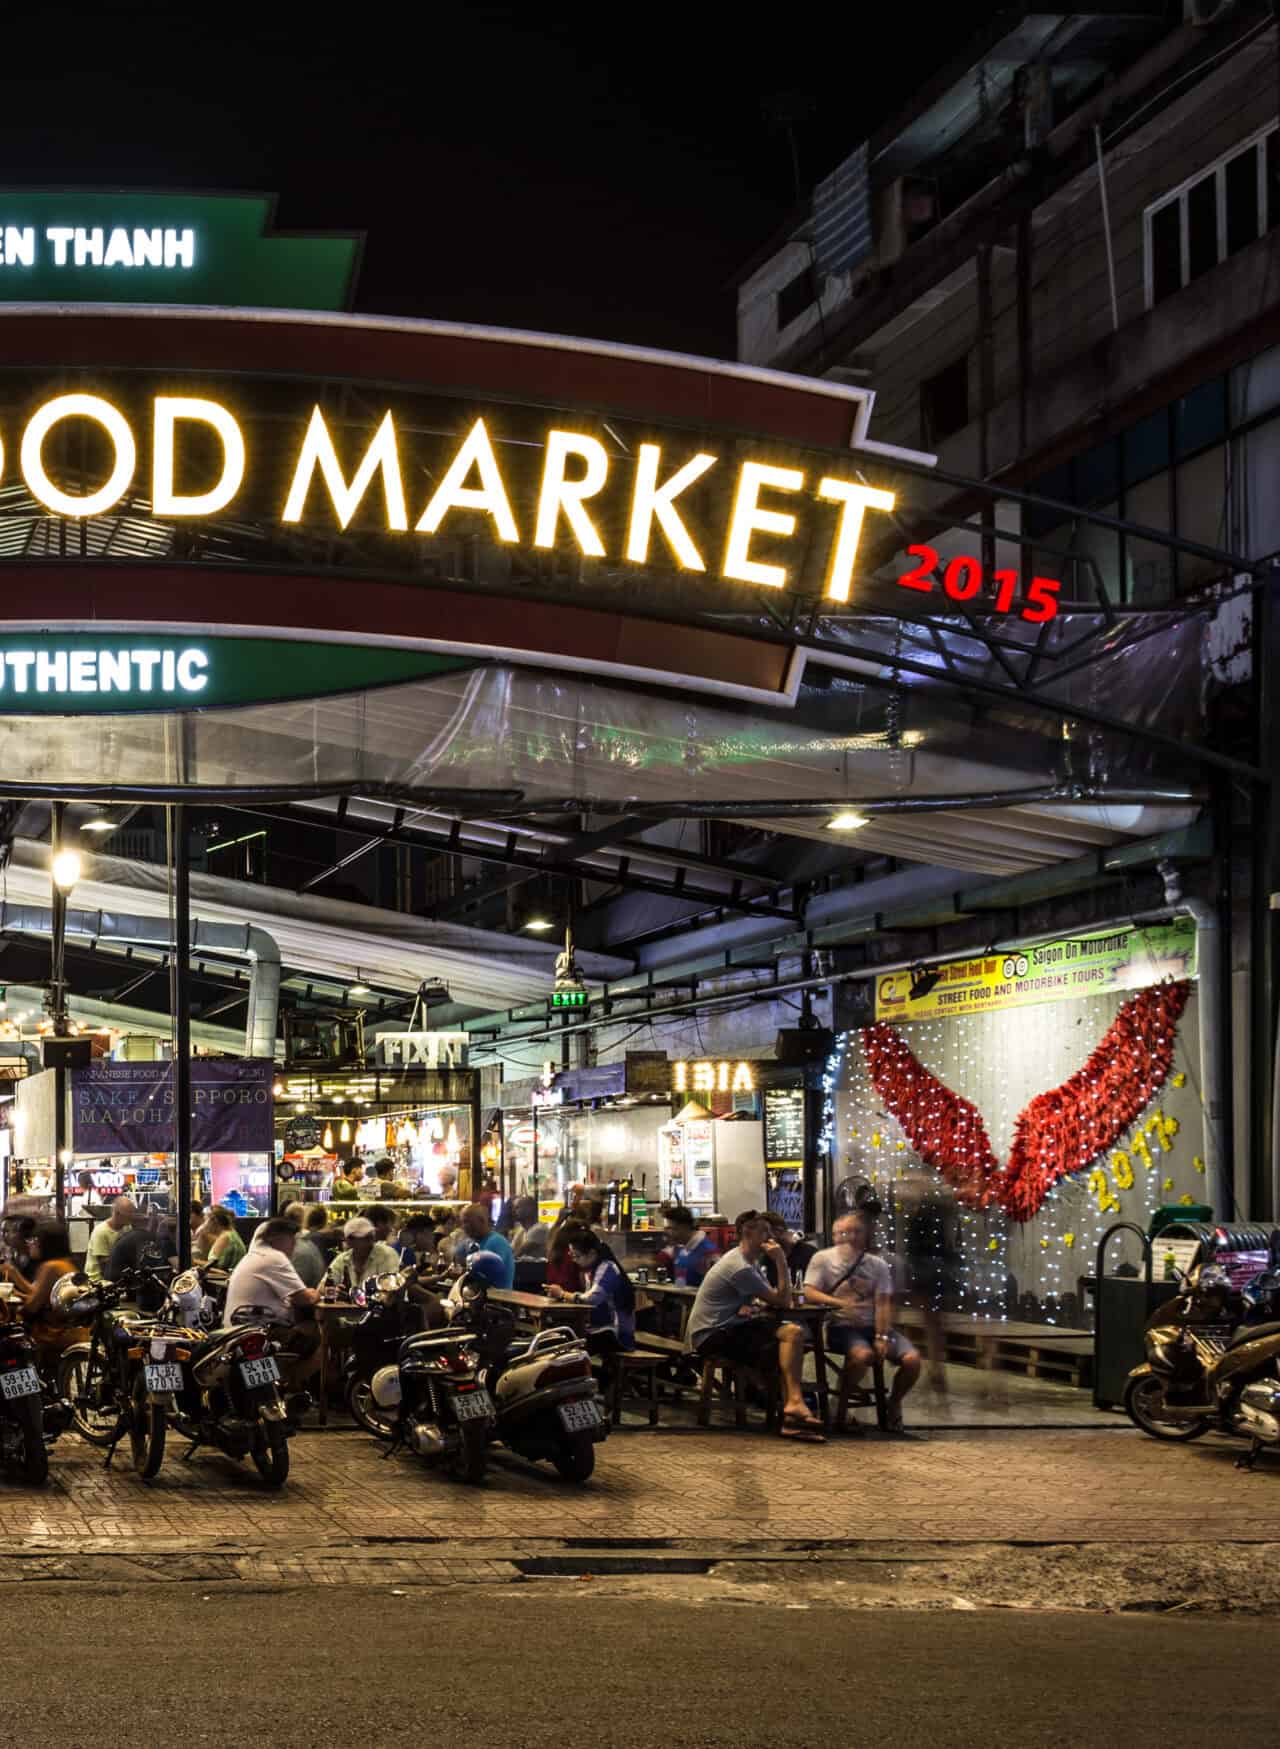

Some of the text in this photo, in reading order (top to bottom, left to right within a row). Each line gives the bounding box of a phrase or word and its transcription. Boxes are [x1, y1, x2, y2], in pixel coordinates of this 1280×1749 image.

[46, 227, 194, 267] THANH
[281, 405, 897, 604] MARKET
[898, 544, 1061, 623] 2015
[1032, 946, 1063, 965] Saigon
[1065, 944, 1077, 959] On
[552, 993, 585, 1007] EXIT
[937, 991, 967, 1006] STREET
[970, 986, 991, 1001] FOOD
[994, 983, 1012, 996] AND
[1015, 975, 1068, 992] MOTORBIKE
[1072, 967, 1105, 983] TOURS
[80, 1088, 268, 1105] SAKE SPPORO
